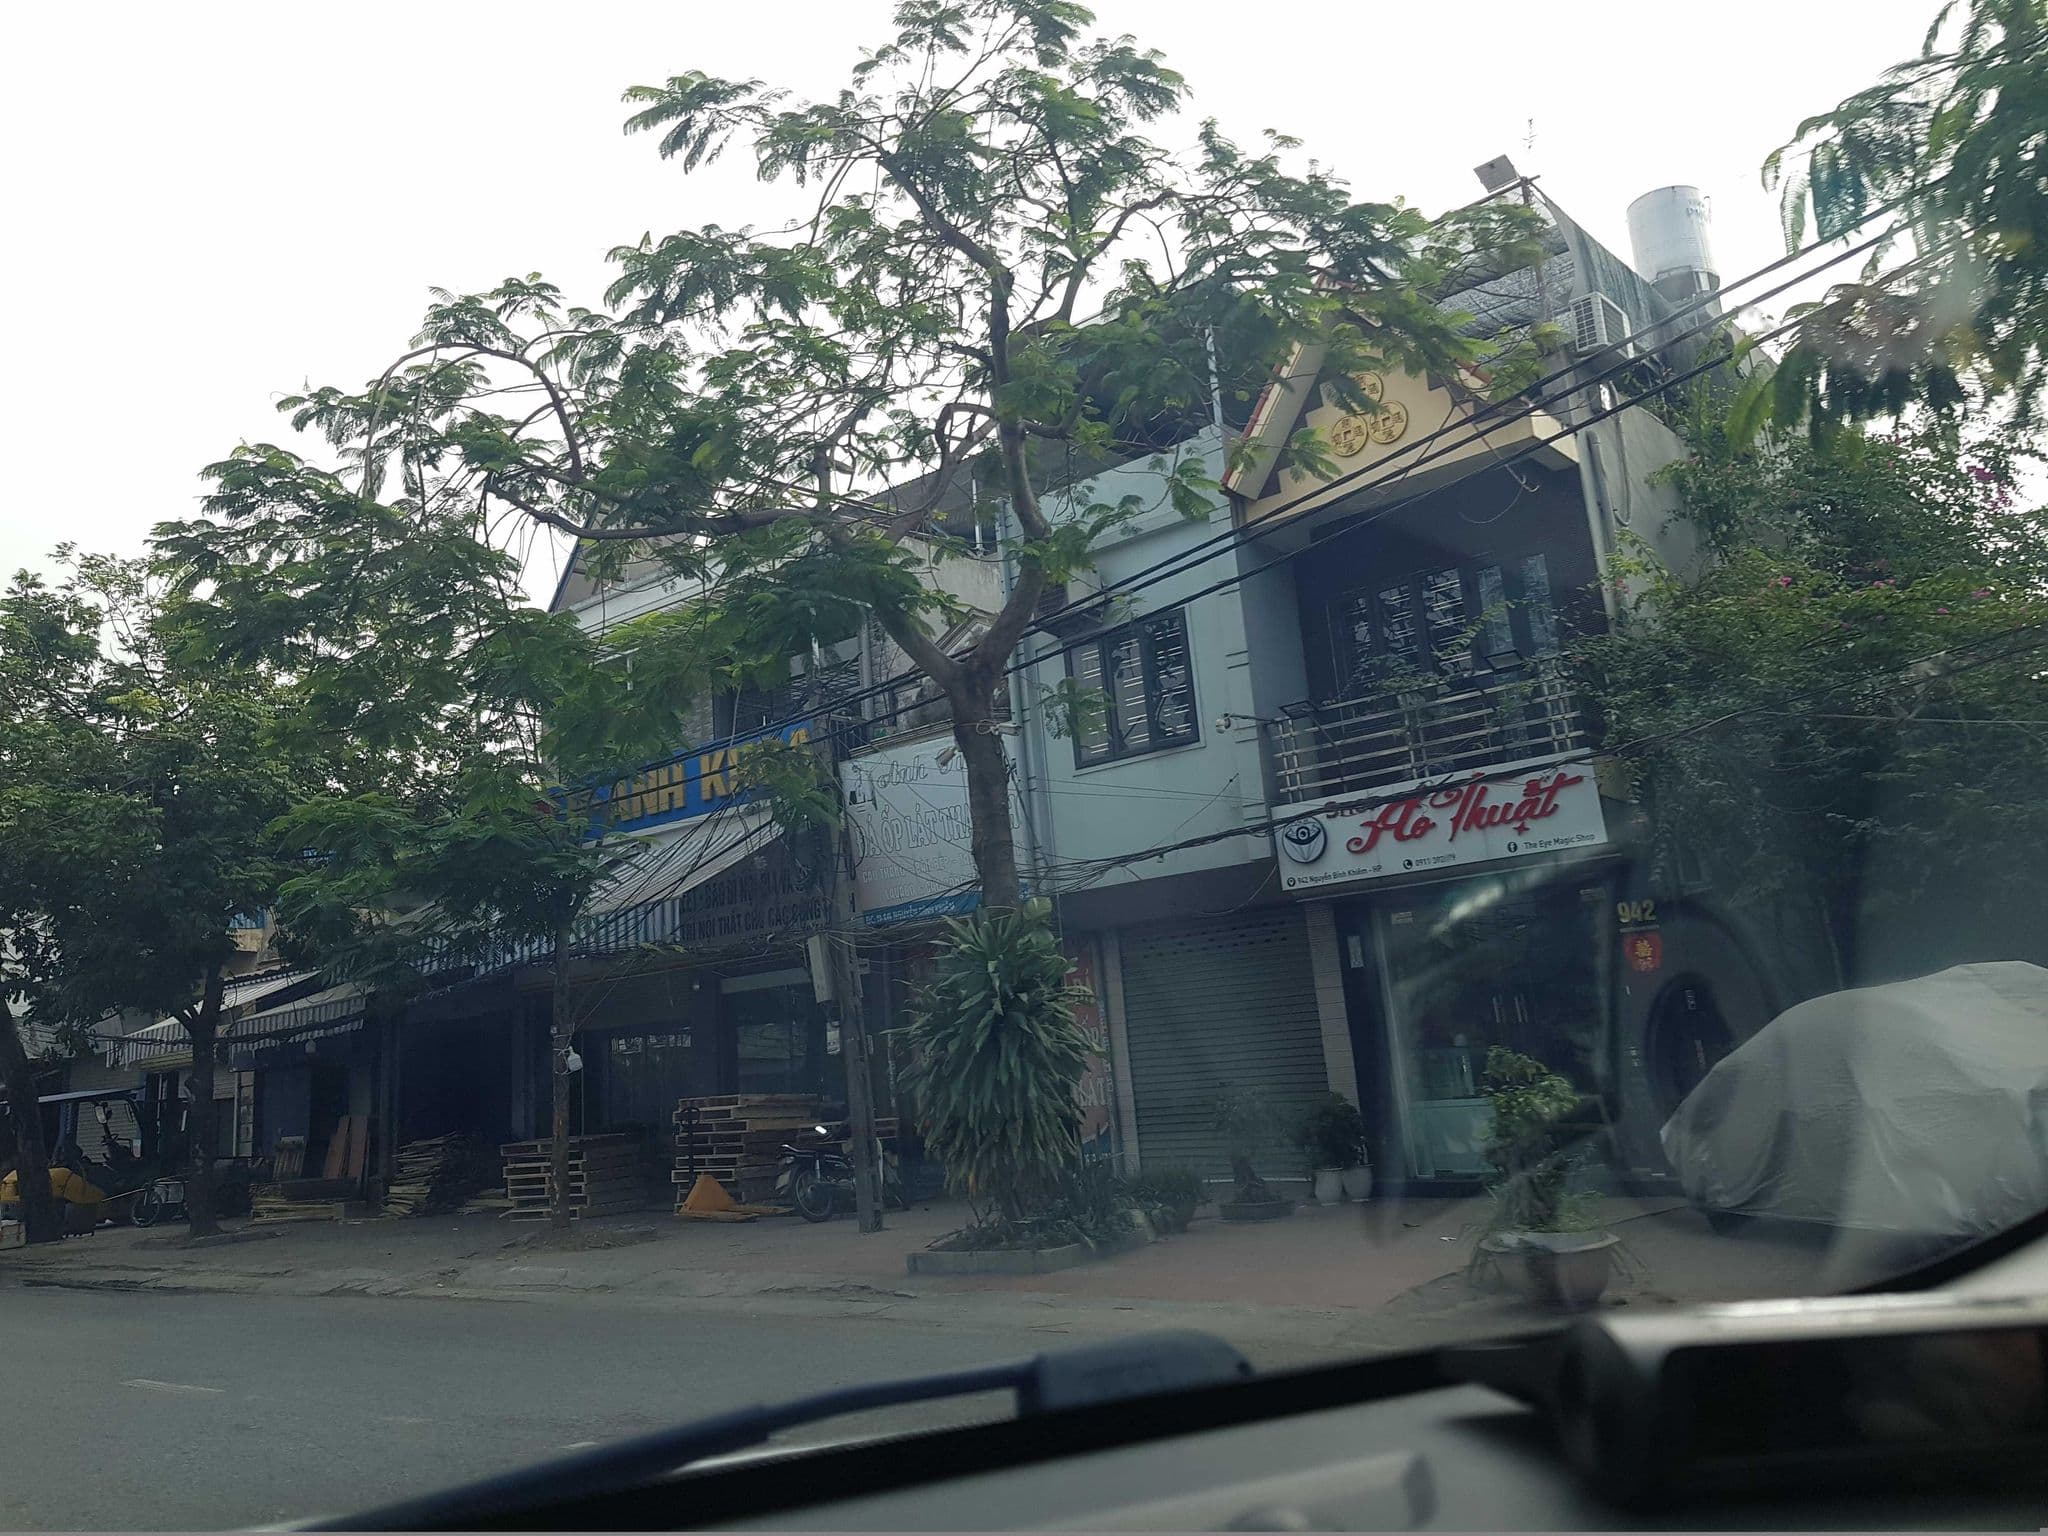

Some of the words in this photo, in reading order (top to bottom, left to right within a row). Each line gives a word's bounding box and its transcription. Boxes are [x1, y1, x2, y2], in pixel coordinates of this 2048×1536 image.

[613, 763, 686, 822] ANH
[1428, 772, 1583, 843] Thuật
[1523, 841, 1538, 849] The
[1538, 839, 1553, 849] Eye
[1552, 836, 1576, 846] Magic
[1575, 833, 1596, 843] Shop
[1616, 899, 1657, 923] 942
